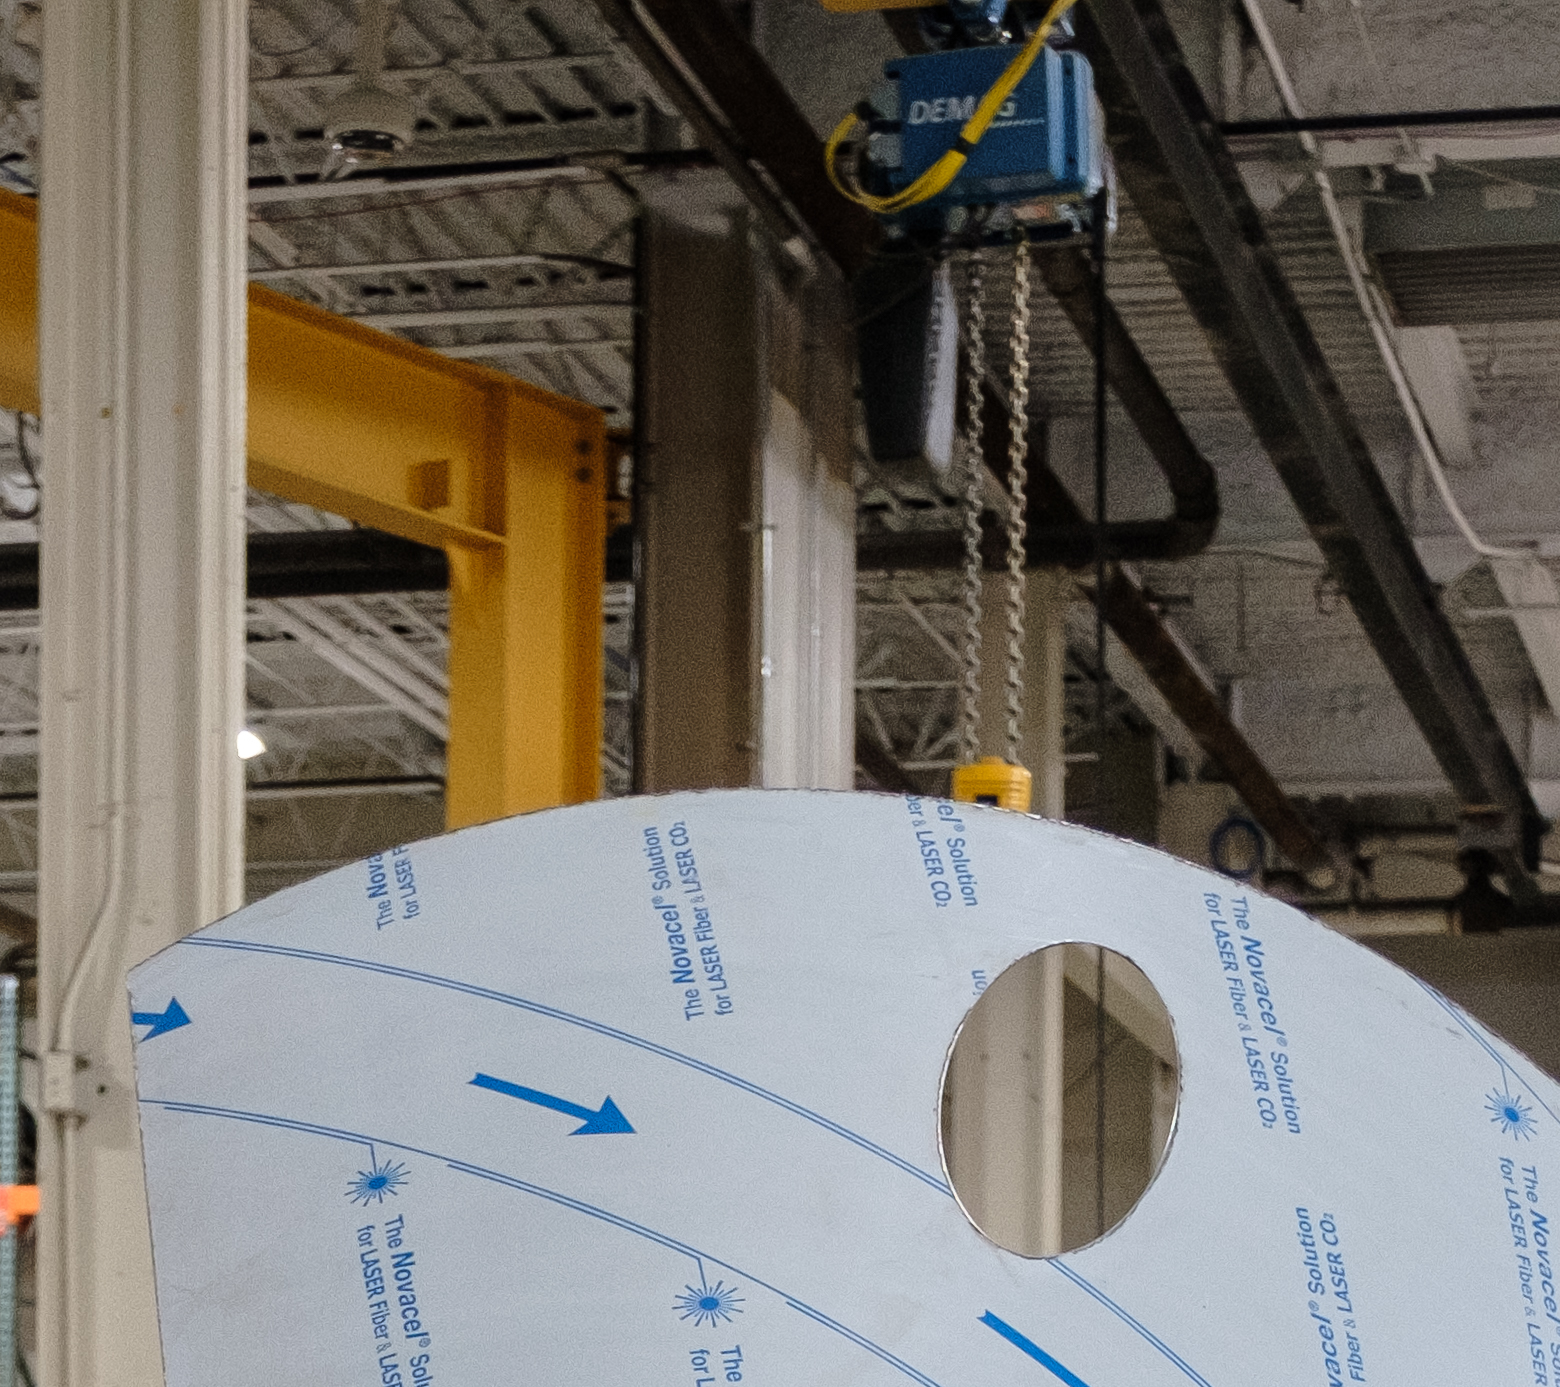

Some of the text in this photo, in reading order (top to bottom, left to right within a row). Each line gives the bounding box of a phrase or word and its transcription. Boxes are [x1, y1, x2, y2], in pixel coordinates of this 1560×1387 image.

[643, 827, 671, 891] Solution
[675, 848, 702, 894] LASER
[916, 830, 944, 877] LASER
[946, 838, 978, 906] Solution
[693, 907, 715, 942] Fiber
[1203, 893, 1221, 916] for
[700, 944, 728, 991] LASER
[1210, 919, 1239, 971] LASER
[684, 989, 704, 1021] The
[714, 995, 734, 1016] for
[1226, 977, 1248, 1020] Fiber
[1232, 897, 1250, 930] The
[1270, 1052, 1301, 1134] Solution
[1241, 1037, 1269, 1092] LASER
[1499, 1157, 1514, 1184] for
[1521, 1166, 1538, 1203] The
[357, 1225, 376, 1247] for
[385, 1214, 405, 1249] The
[1504, 1188, 1528, 1248] LASER
[360, 1249, 384, 1300] LASER
[1295, 1207, 1325, 1295] Solution
[1327, 1252, 1353, 1313] LASER
[1516, 1254, 1534, 1304] Fiber
[369, 1300, 389, 1339] Fiber
[689, 1349, 710, 1373] for
[720, 1345, 743, 1382] The
[1346, 1332, 1366, 1382] Fiber
[1527, 1322, 1548, 1386] LASER
